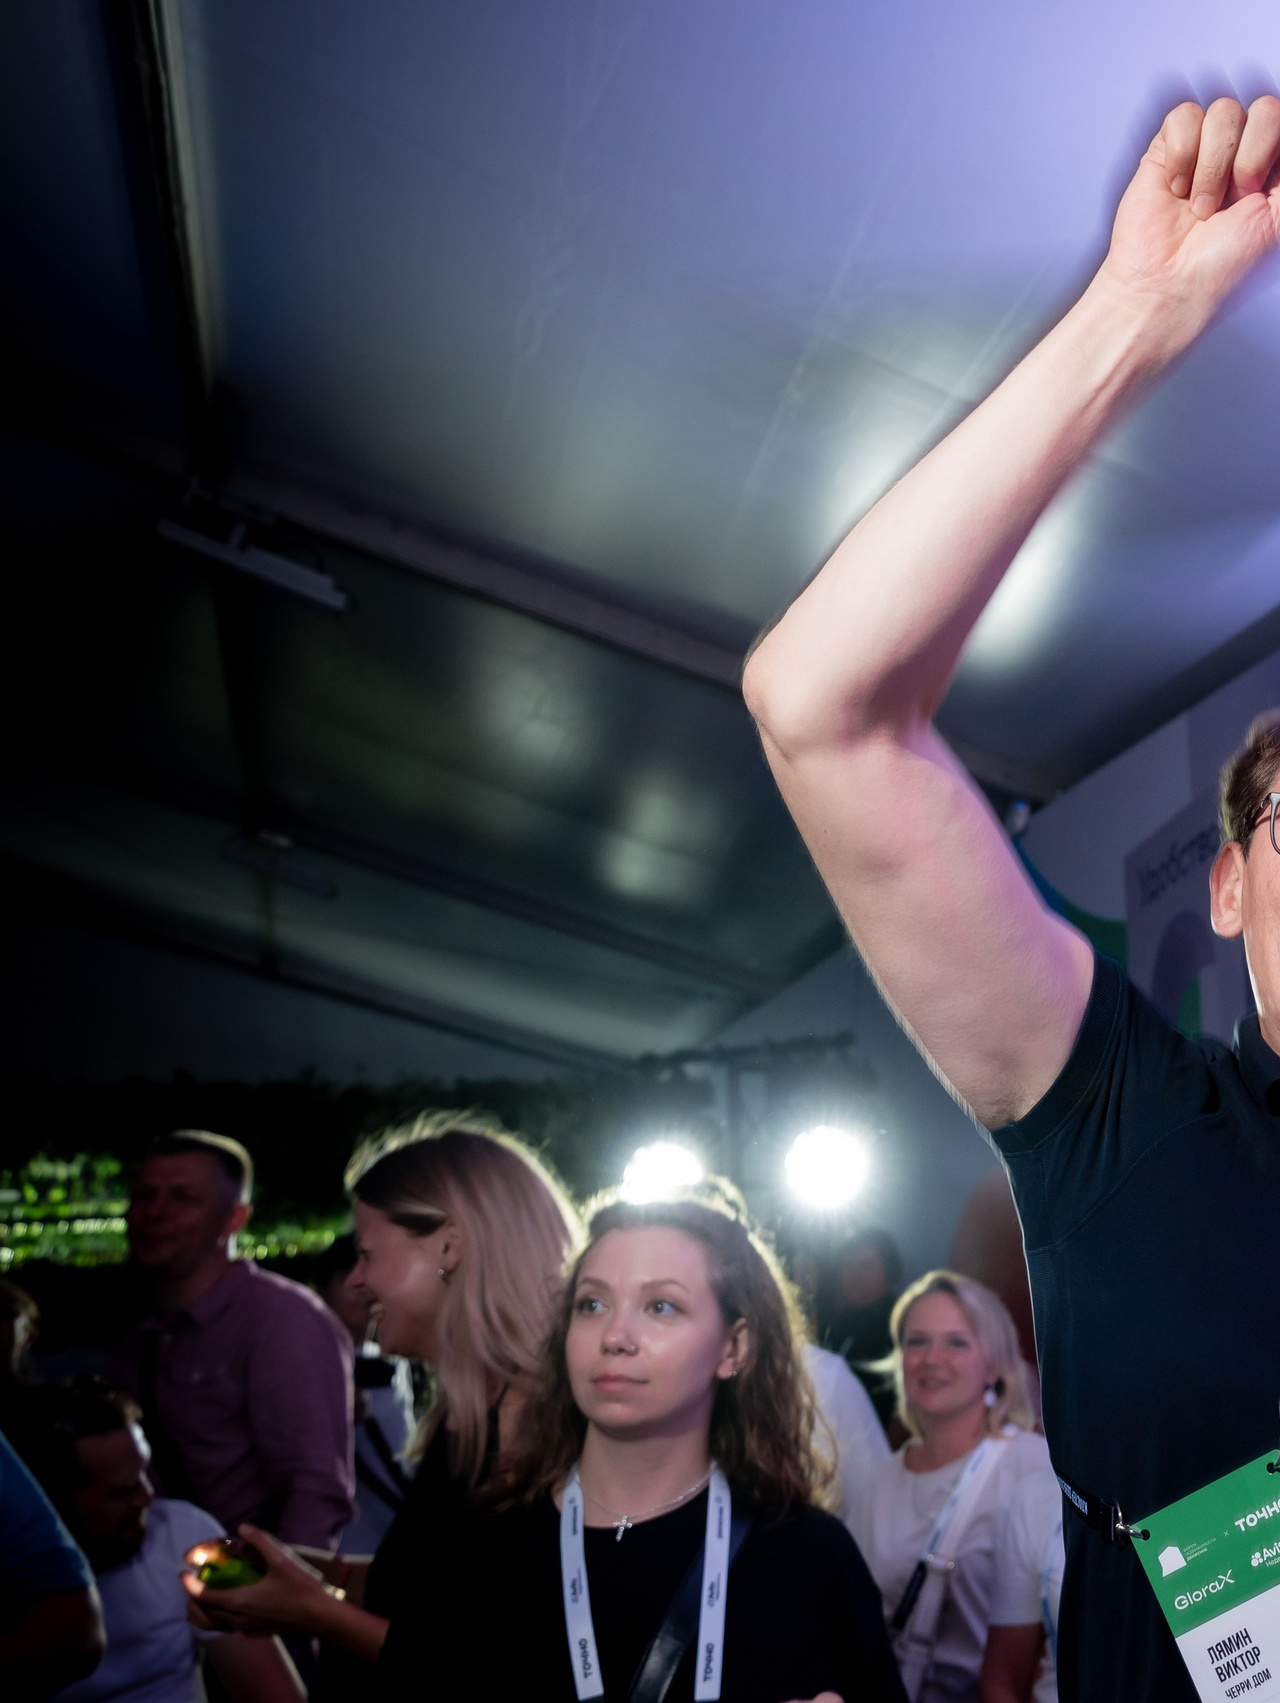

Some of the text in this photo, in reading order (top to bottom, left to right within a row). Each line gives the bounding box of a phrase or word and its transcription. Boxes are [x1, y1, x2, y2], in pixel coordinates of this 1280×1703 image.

[1174, 1569, 1236, 1611] GloraX
[1206, 1627, 1253, 1665] ЛЯМИН
[1214, 1646, 1261, 1683] ВИКТОР
[1225, 1668, 1273, 1700] ЧЕРРИ ДОМ
